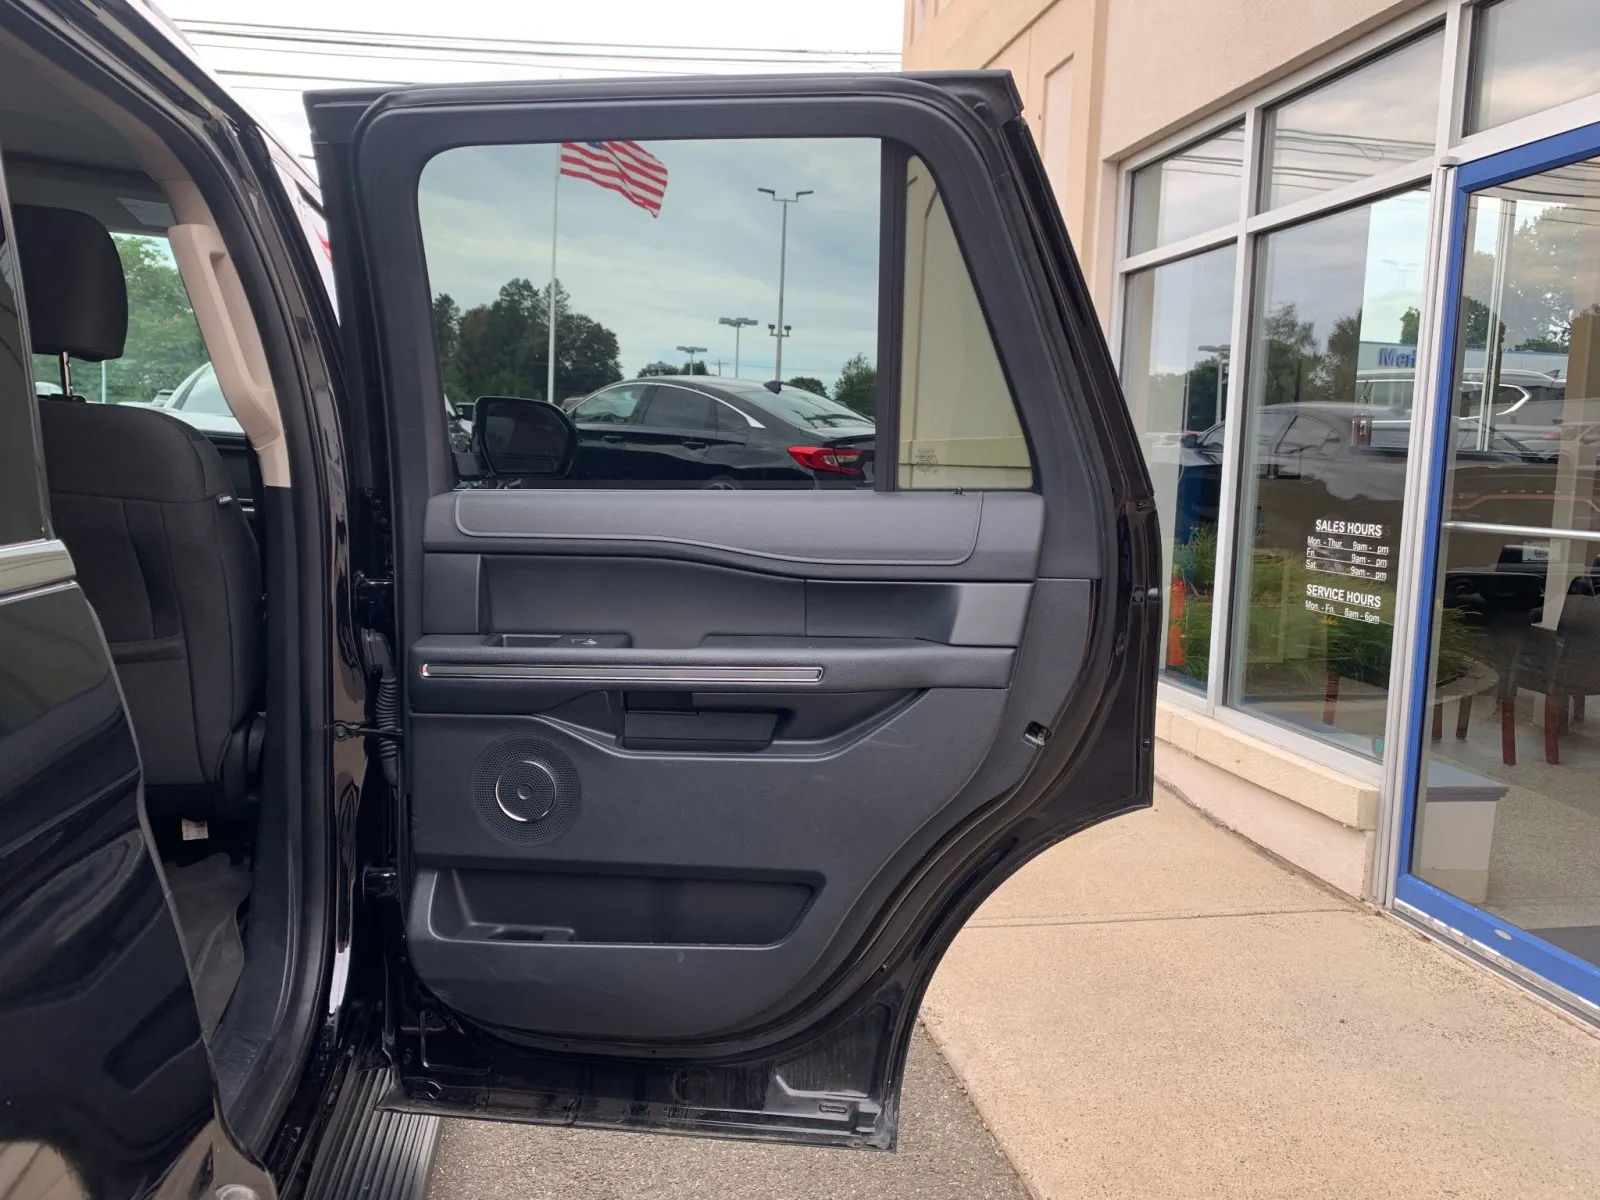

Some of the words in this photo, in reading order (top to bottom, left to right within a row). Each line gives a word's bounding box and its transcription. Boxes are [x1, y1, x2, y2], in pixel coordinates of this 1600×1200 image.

[1315, 519, 1345, 533] SALES
[1347, 522, 1382, 537] HOURS
[1352, 541, 1368, 551] 9am
[1377, 545, 1389, 555] pm
[1351, 553, 1366, 564] 9am
[1375, 558, 1387, 568] pm
[1350, 566, 1366, 576] 9am
[1375, 571, 1387, 581] pm
[1306, 584, 1345, 601] SERVICE
[1346, 591, 1381, 608] HOURS
[1305, 600, 1320, 611] Mon.
[1344, 608, 1359, 619] 8am
[1364, 611, 1380, 624] 6pm
